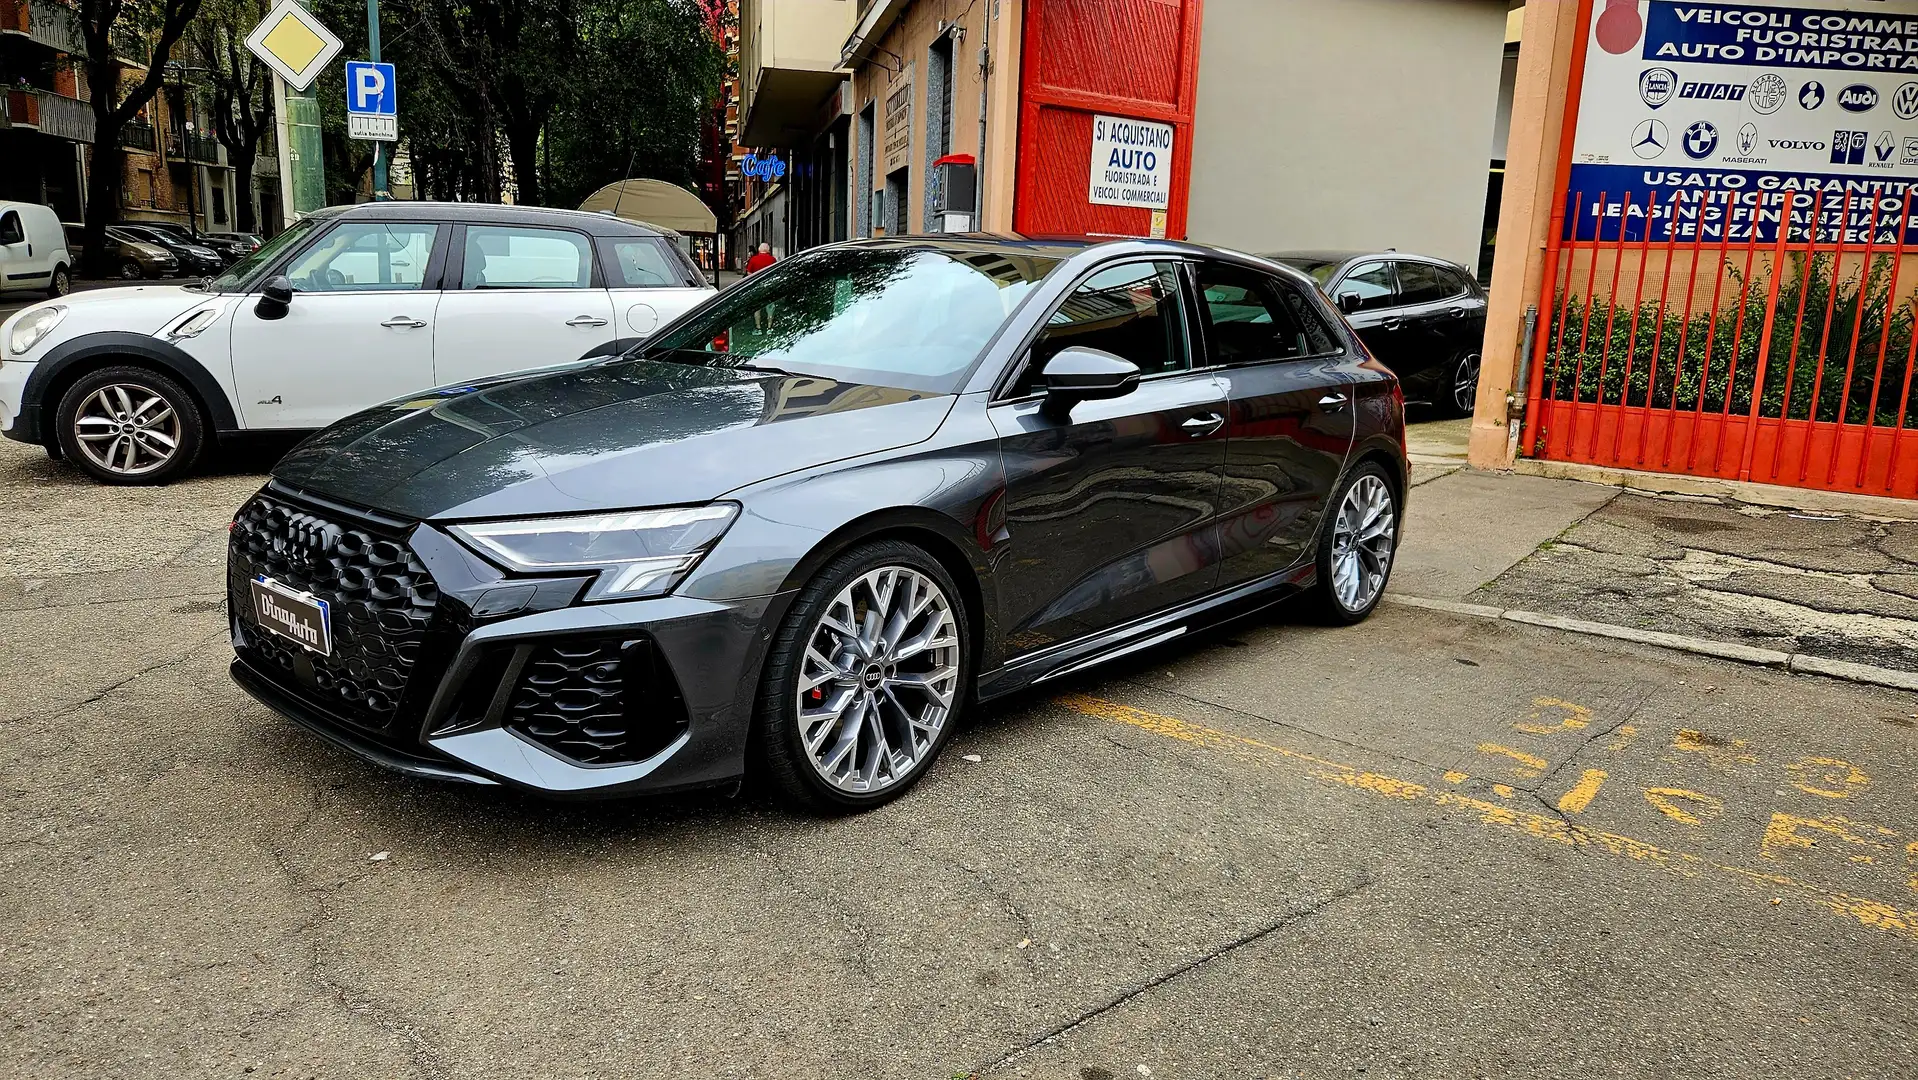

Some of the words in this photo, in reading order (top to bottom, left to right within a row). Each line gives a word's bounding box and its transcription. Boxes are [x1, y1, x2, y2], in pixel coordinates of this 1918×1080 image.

[1674, 8, 1791, 28] VEICOLI
[1655, 42, 1745, 60] AUTO
[356, 67, 385, 108] P
[1648, 82, 1667, 91] LANCIA
[1682, 83, 1746, 99] FIAT
[1840, 90, 1877, 106] Audi
[1097, 120, 1106, 141] SI
[1110, 122, 1170, 149] ACQUISTANO
[1768, 139, 1826, 151] VOLVO
[1108, 147, 1156, 171] AUTO
[1722, 156, 1768, 165] MASERATI
[1868, 161, 1895, 169] RENAULT
[1104, 170, 1151, 186] FUORISTRADA
[1153, 175, 1157, 186] E
[1643, 171, 1747, 188] USATO
[1094, 186, 1119, 199] VEICOLI
[1121, 189, 1167, 203] COMMERCIALI
[1824, 195, 1903, 211] ZERO
[1591, 203, 1722, 221] LEASING
[1663, 221, 1764, 238] SENZA
